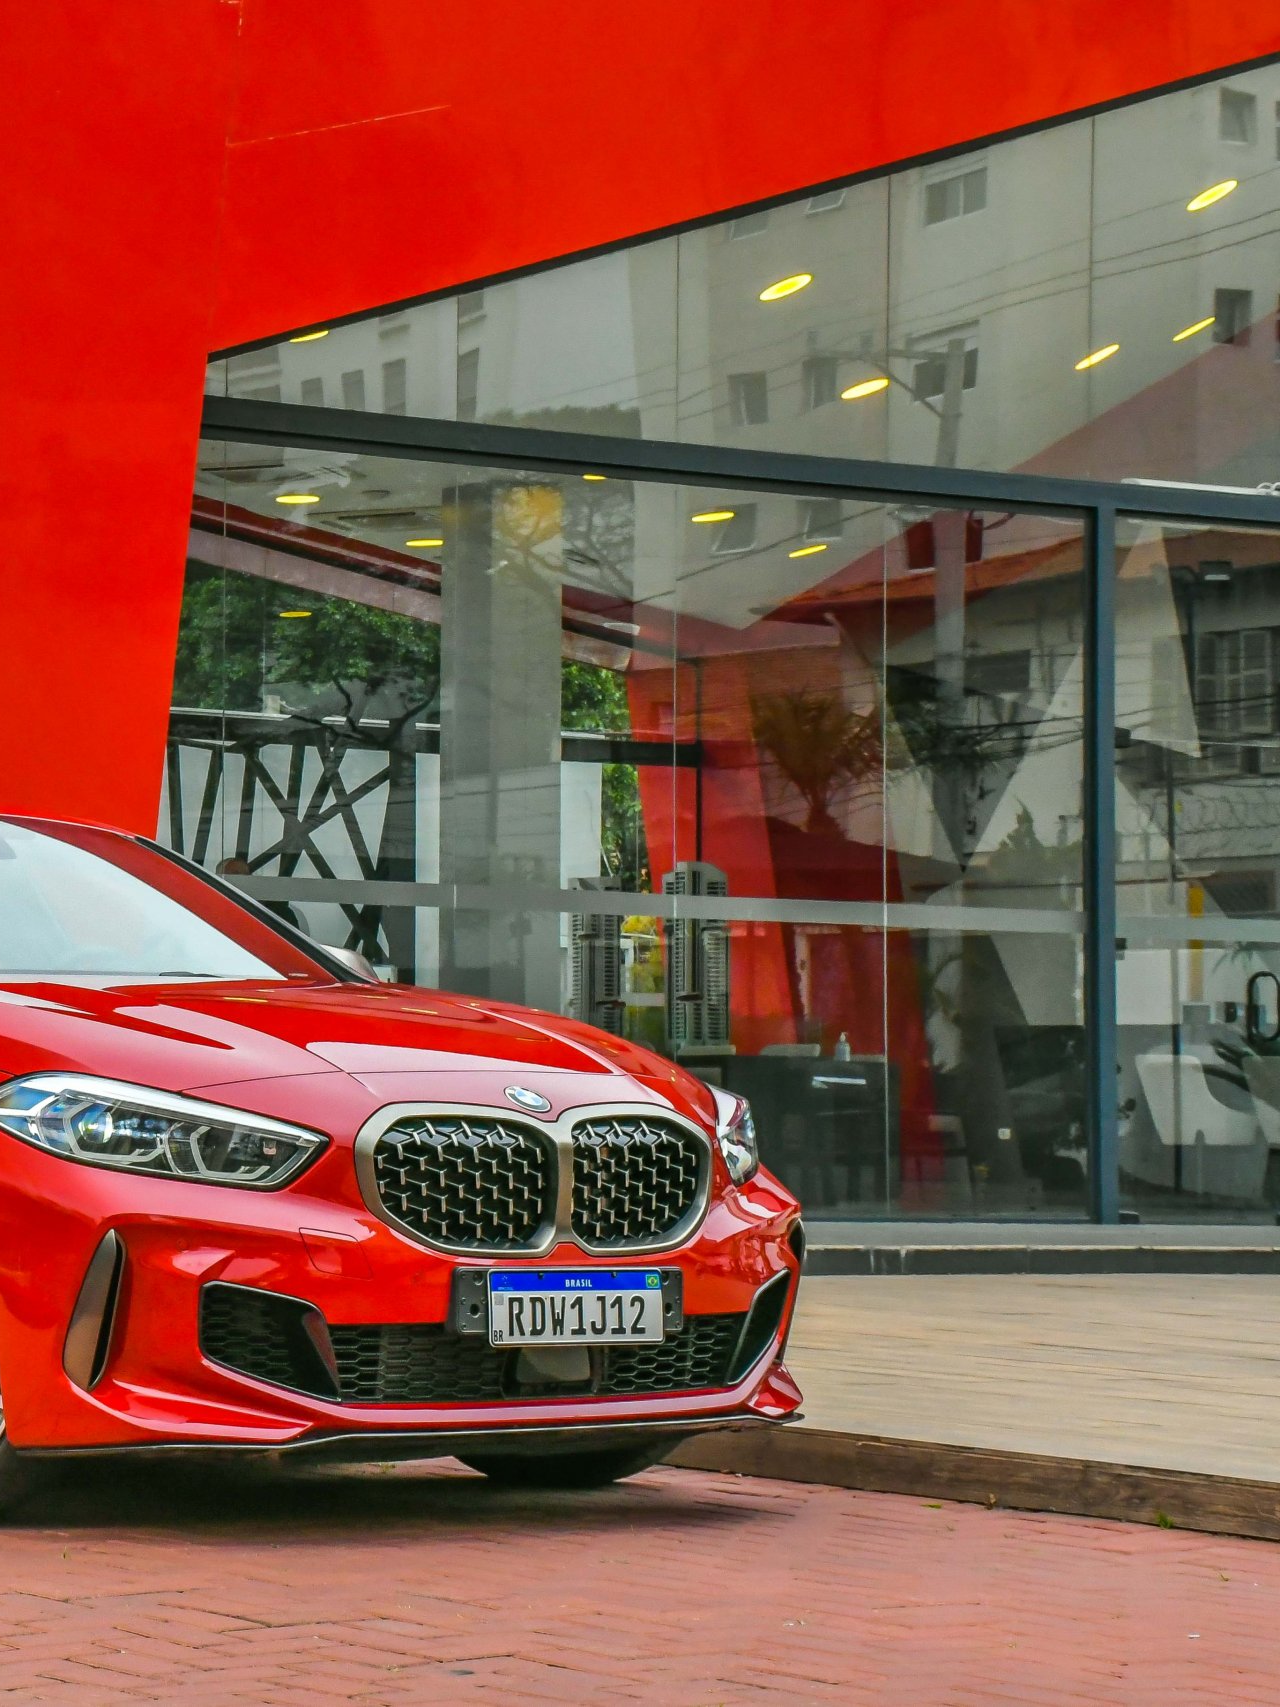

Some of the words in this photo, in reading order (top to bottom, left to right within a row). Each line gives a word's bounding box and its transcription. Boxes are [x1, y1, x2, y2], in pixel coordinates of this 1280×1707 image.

[565, 1279, 593, 1288] BRASIL
[508, 1296, 647, 1337] RDW1J12
[493, 1330, 504, 1343] BR
